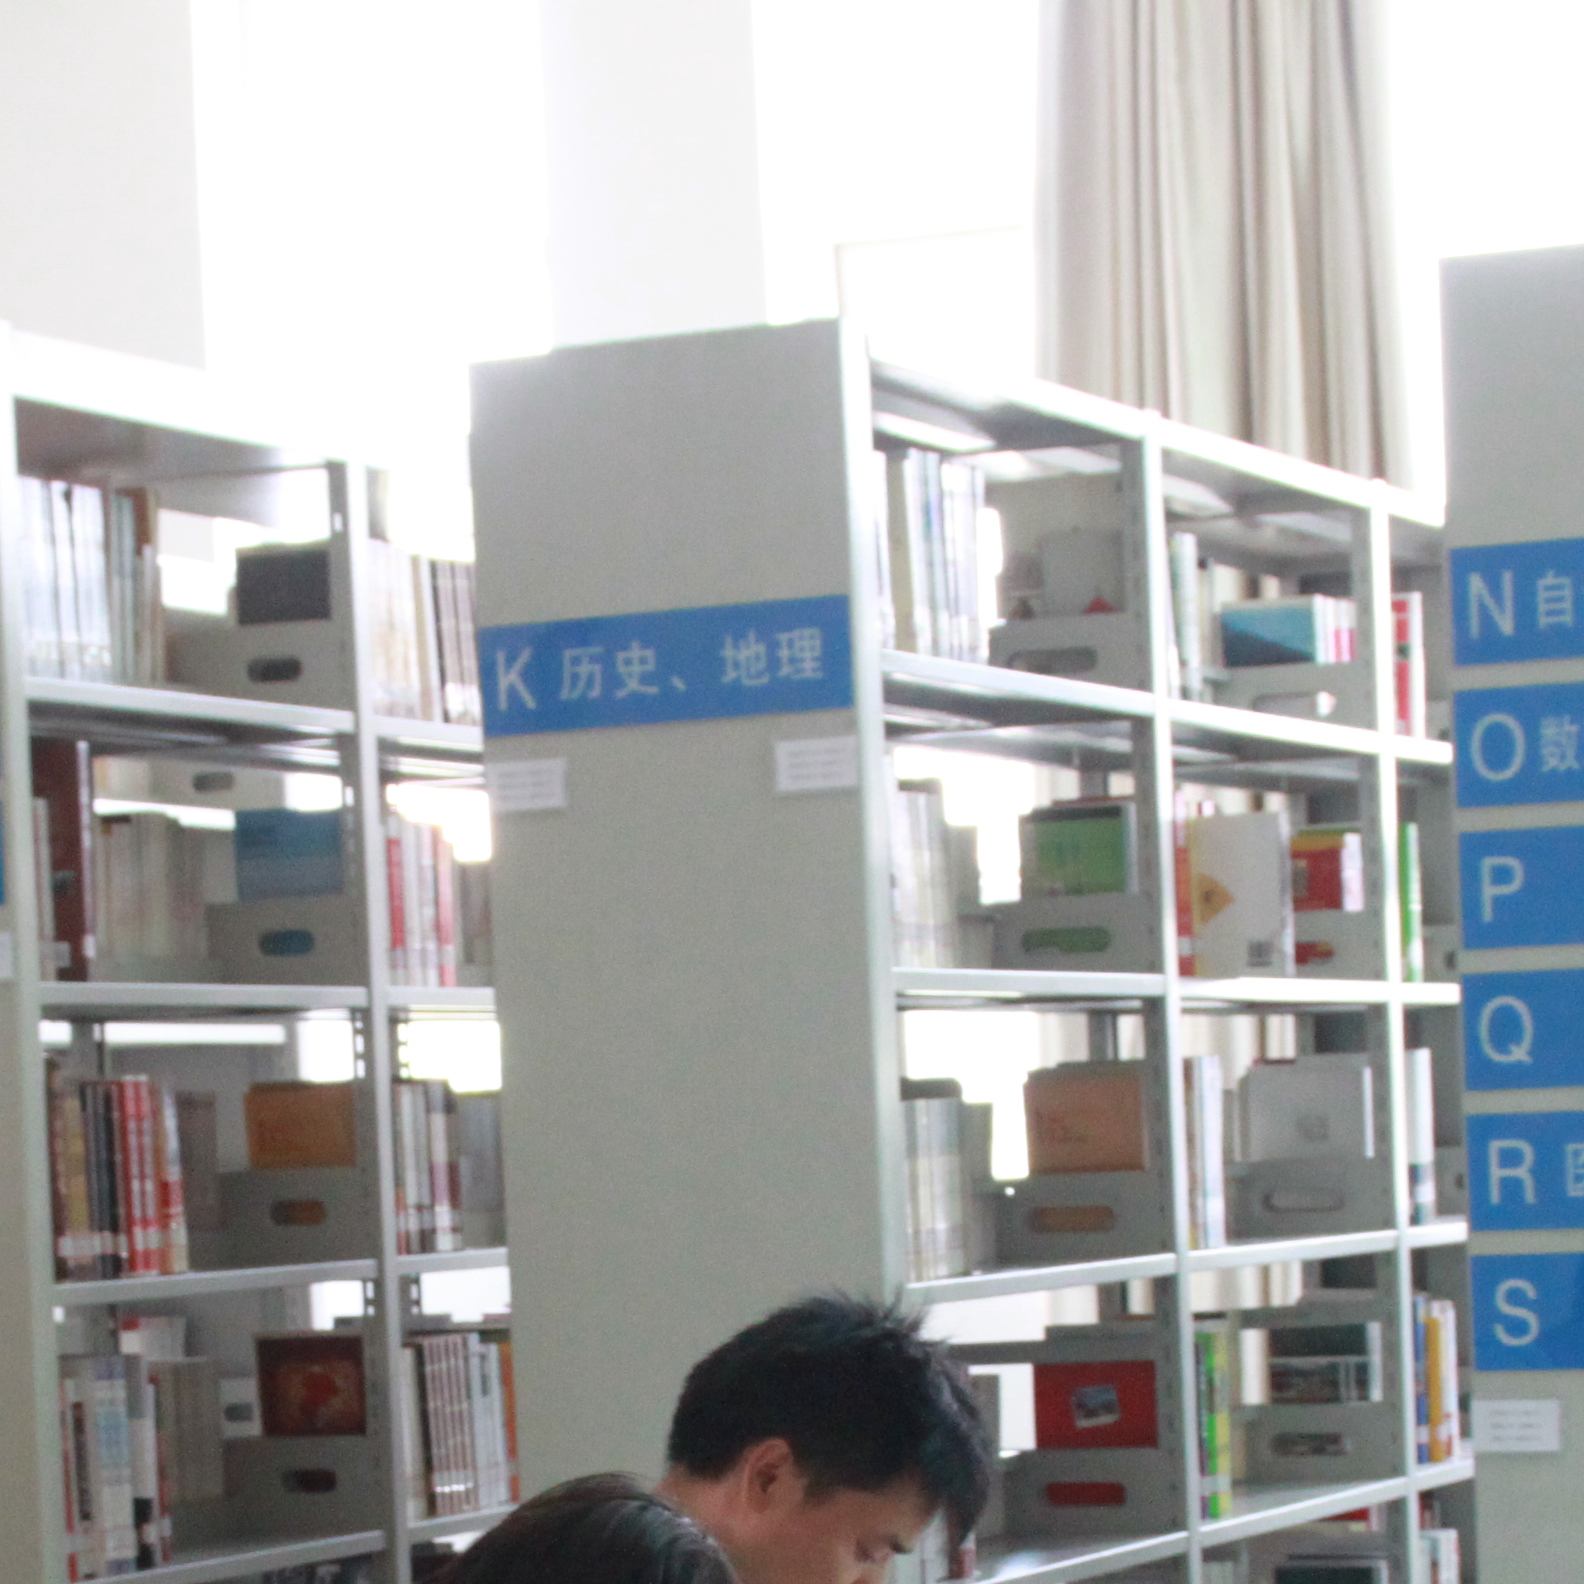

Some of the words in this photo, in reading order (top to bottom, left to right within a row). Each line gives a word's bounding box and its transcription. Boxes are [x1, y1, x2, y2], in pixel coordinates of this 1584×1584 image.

[1467, 571, 1514, 639] N
[496, 646, 537, 712] K
[1470, 713, 1525, 781] O
[1480, 856, 1524, 922] P
[1479, 996, 1534, 1063] Q
[1487, 1139, 1536, 1204] R
[1494, 1279, 1540, 1346] S
